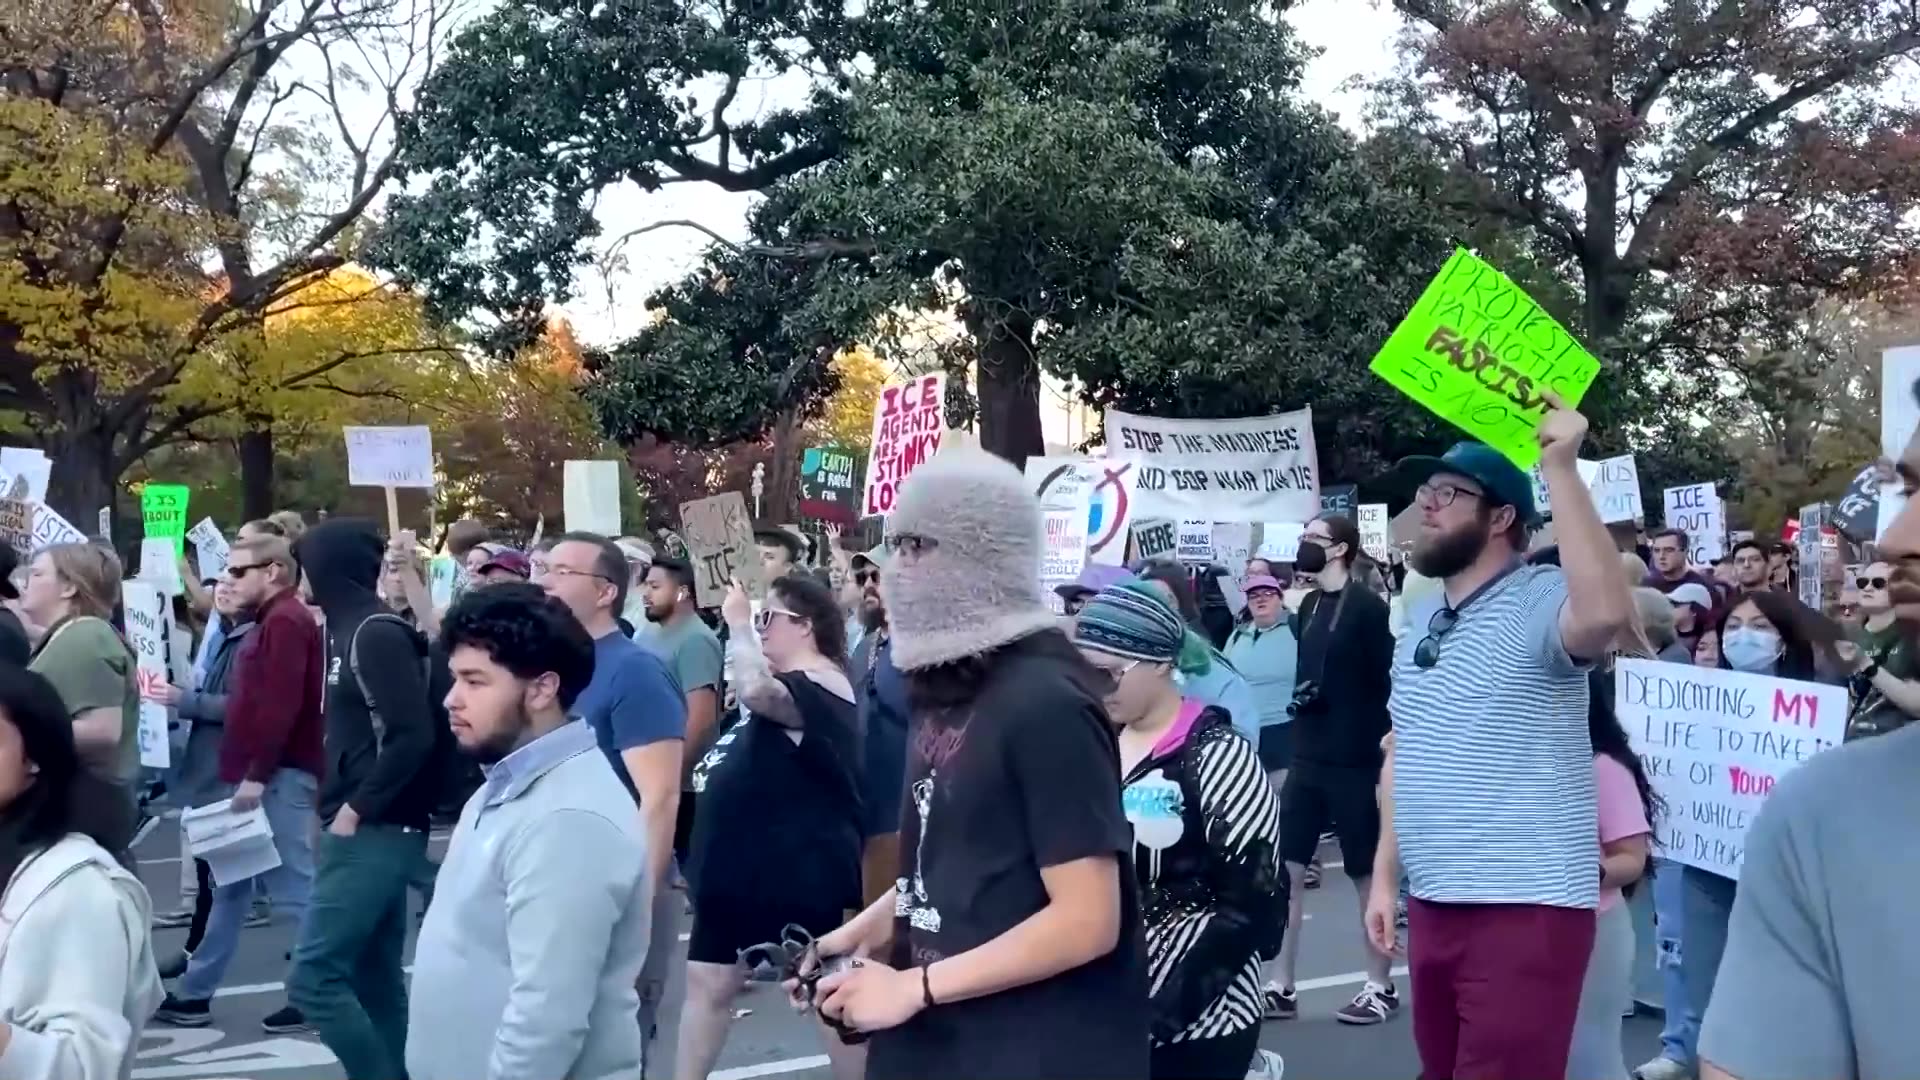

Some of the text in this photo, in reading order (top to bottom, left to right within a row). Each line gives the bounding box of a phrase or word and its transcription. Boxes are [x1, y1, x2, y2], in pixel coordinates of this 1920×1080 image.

[1442, 253, 1580, 361] PROTEST
[1429, 289, 1569, 397] PATRIOTIC
[1401, 356, 1443, 393] IS
[1424, 325, 1560, 415] FASCIS
[882, 377, 938, 418] ICE
[879, 405, 941, 443] AGENTS
[1121, 426, 1301, 454] STOP THE MADNESS
[873, 438, 899, 461] ARE
[875, 431, 942, 483] STINKY
[1170, 469, 1209, 491] GOP
[1214, 470, 1259, 491] WAR
[1290, 465, 1313, 491] US
[1671, 486, 1706, 510] ICE
[1135, 522, 1176, 558] HERE
[1676, 512, 1714, 532] OUT
[702, 547, 736, 591] ICE
[1623, 669, 1819, 729] DEDICATING MY
[1645, 714, 1808, 762] LIFE TO TAKE
[1640, 752, 1674, 778] ARE
[1689, 760, 1720, 786] OF
[1692, 800, 1746, 830] WHILE
